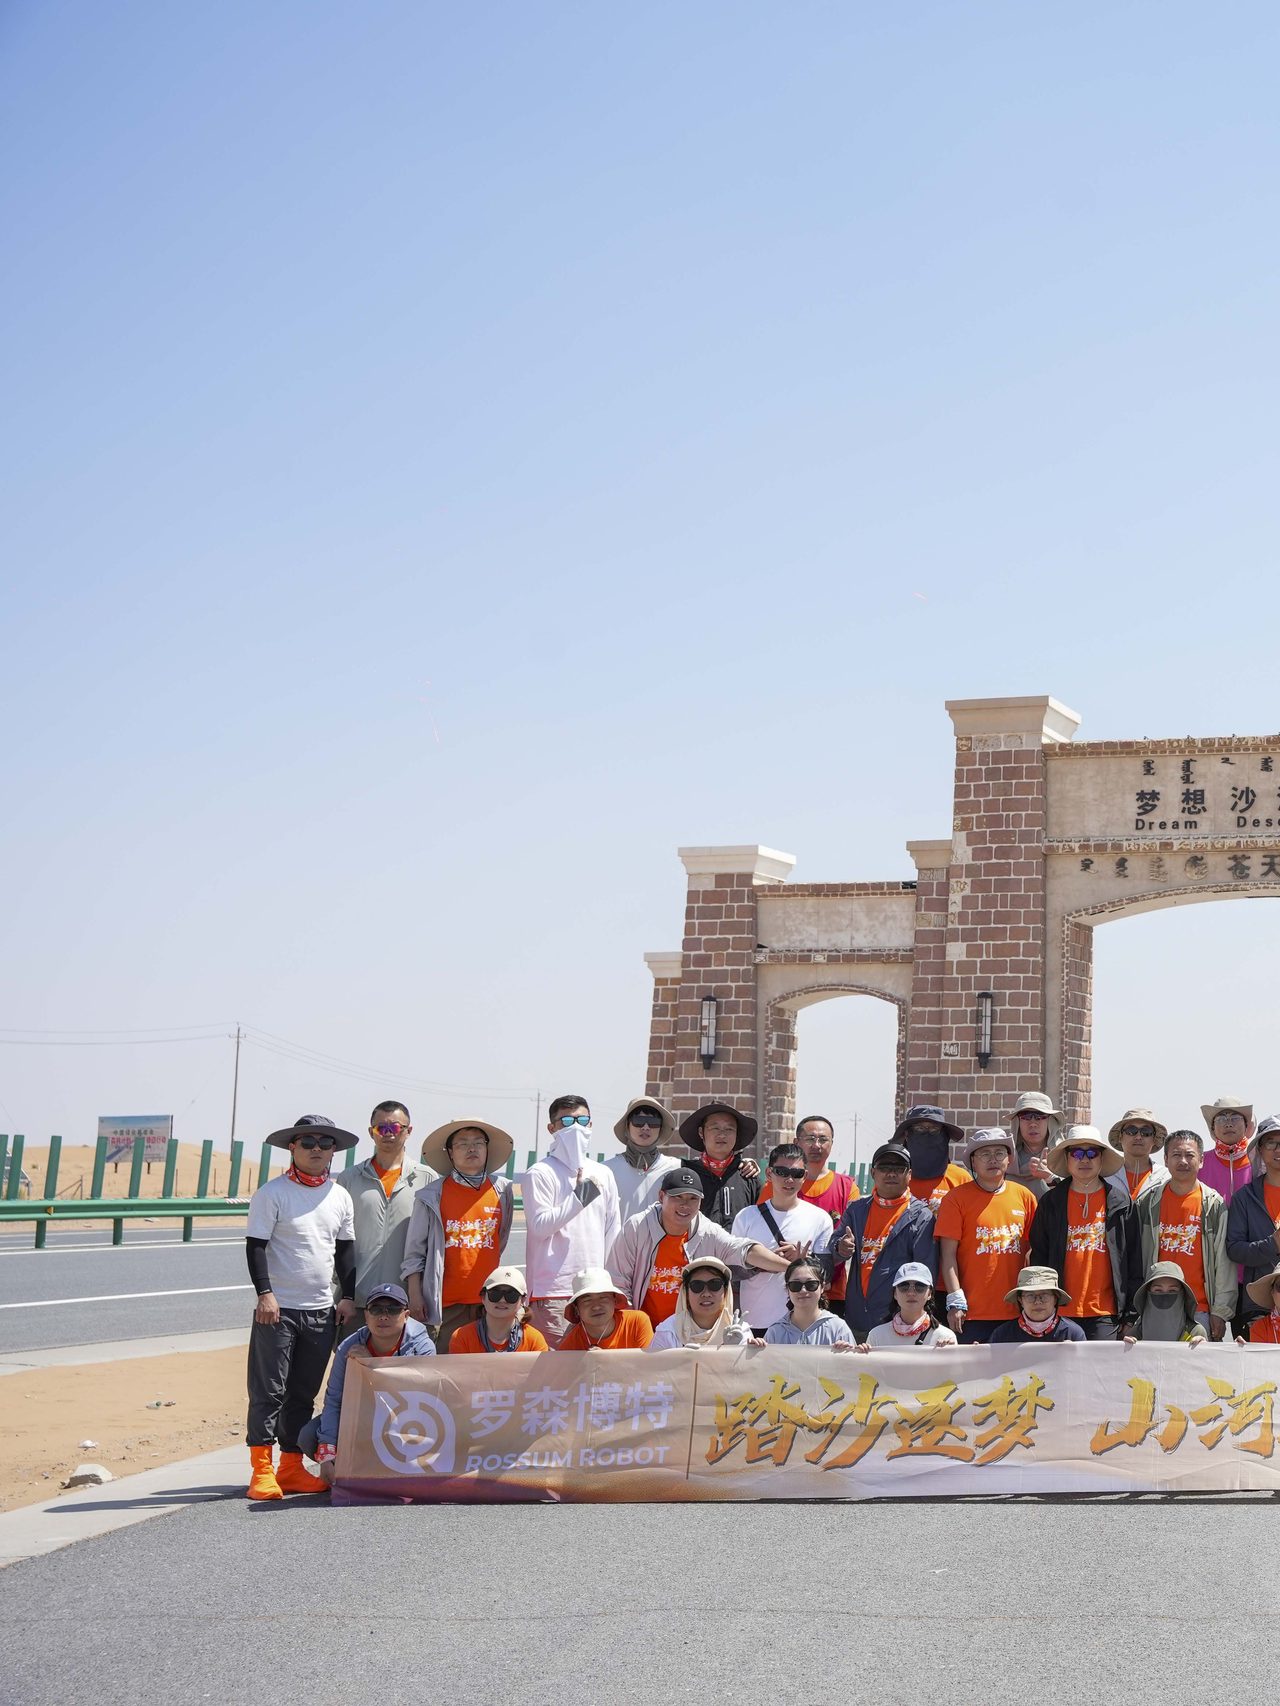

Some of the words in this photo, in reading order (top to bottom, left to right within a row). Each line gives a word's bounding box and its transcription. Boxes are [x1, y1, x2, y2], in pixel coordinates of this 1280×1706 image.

[1135, 818, 1198, 830] Dream
[470, 1381, 675, 1440] 罗森博特
[705, 1372, 1056, 1471] 踏沙逐梦
[465, 1450, 573, 1472] ROSSUM
[579, 1446, 670, 1466] ROBOT
